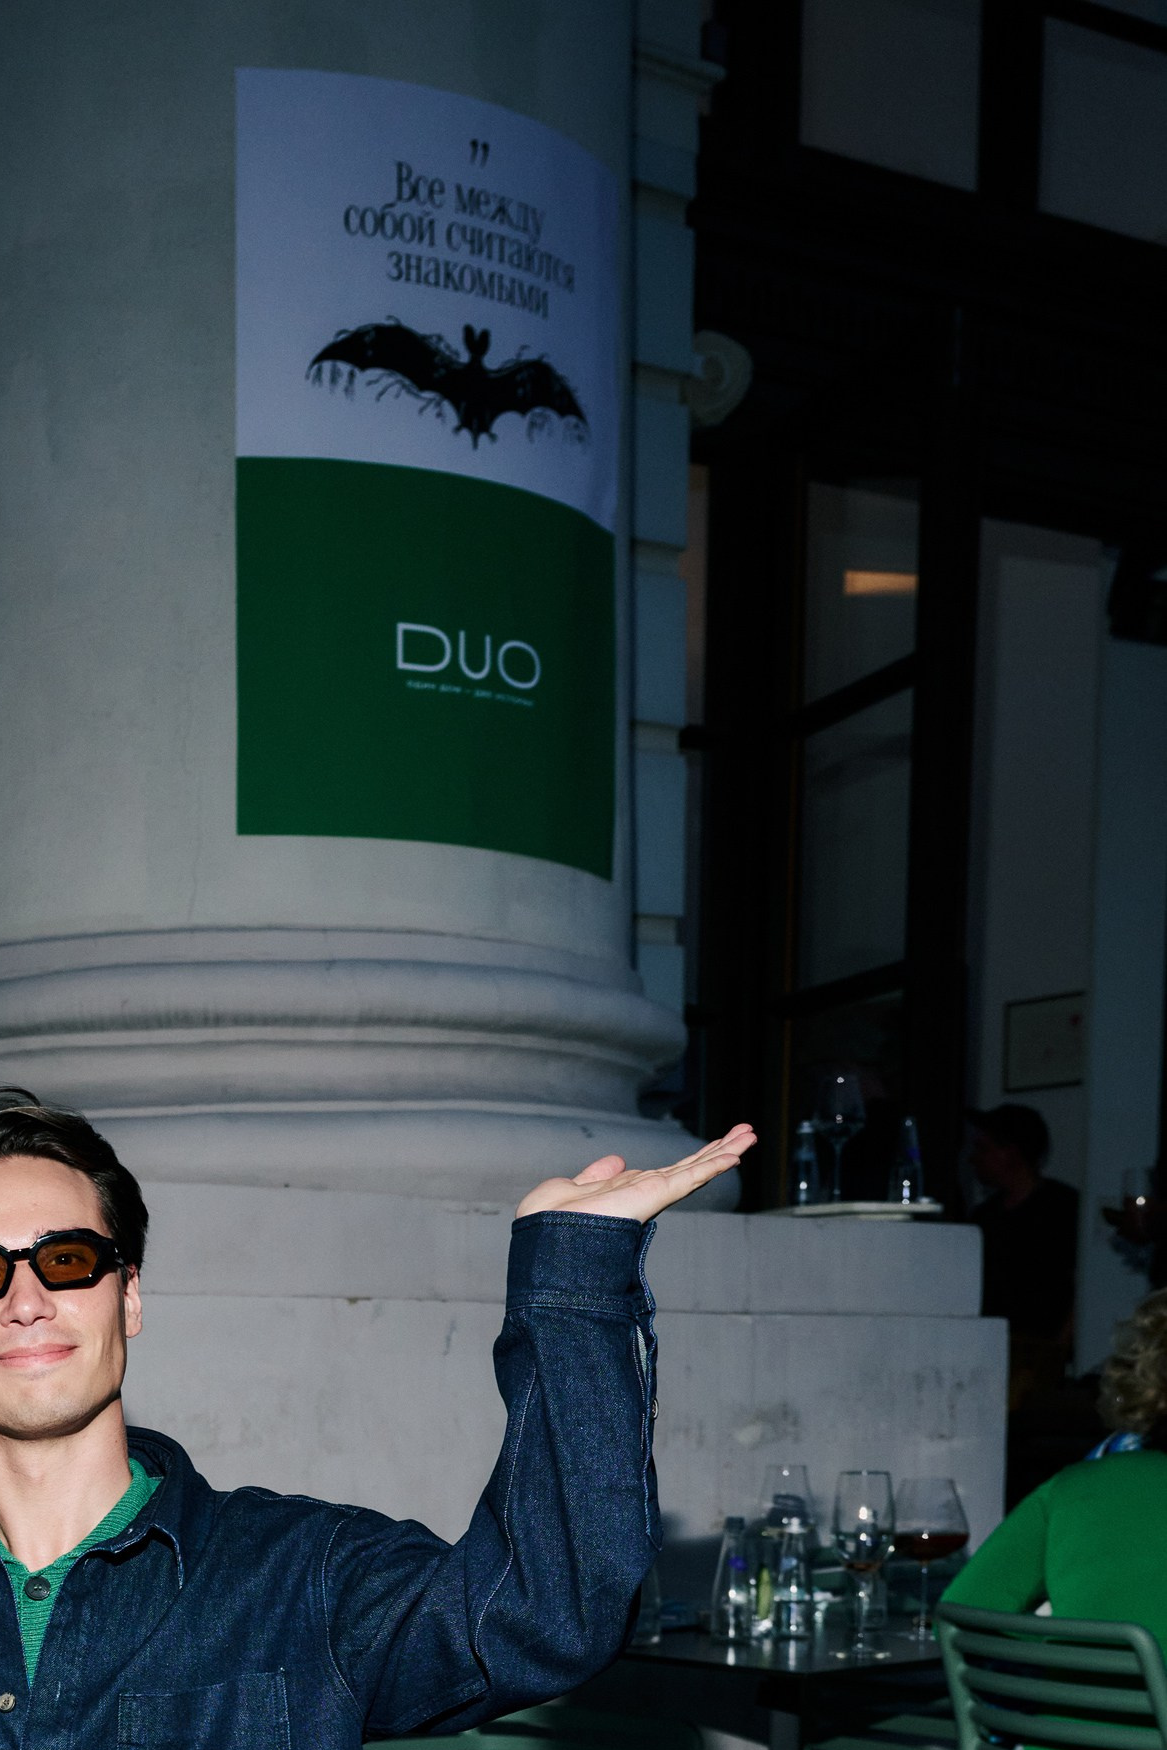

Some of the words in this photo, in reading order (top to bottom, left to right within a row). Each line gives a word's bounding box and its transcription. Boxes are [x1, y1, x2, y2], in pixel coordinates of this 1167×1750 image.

[395, 160, 445, 209] Все
[454, 183, 546, 244] между
[344, 201, 435, 248] собой
[446, 220, 575, 293] считаются
[386, 250, 549, 319] знакомыми
[396, 622, 542, 690] DUO
